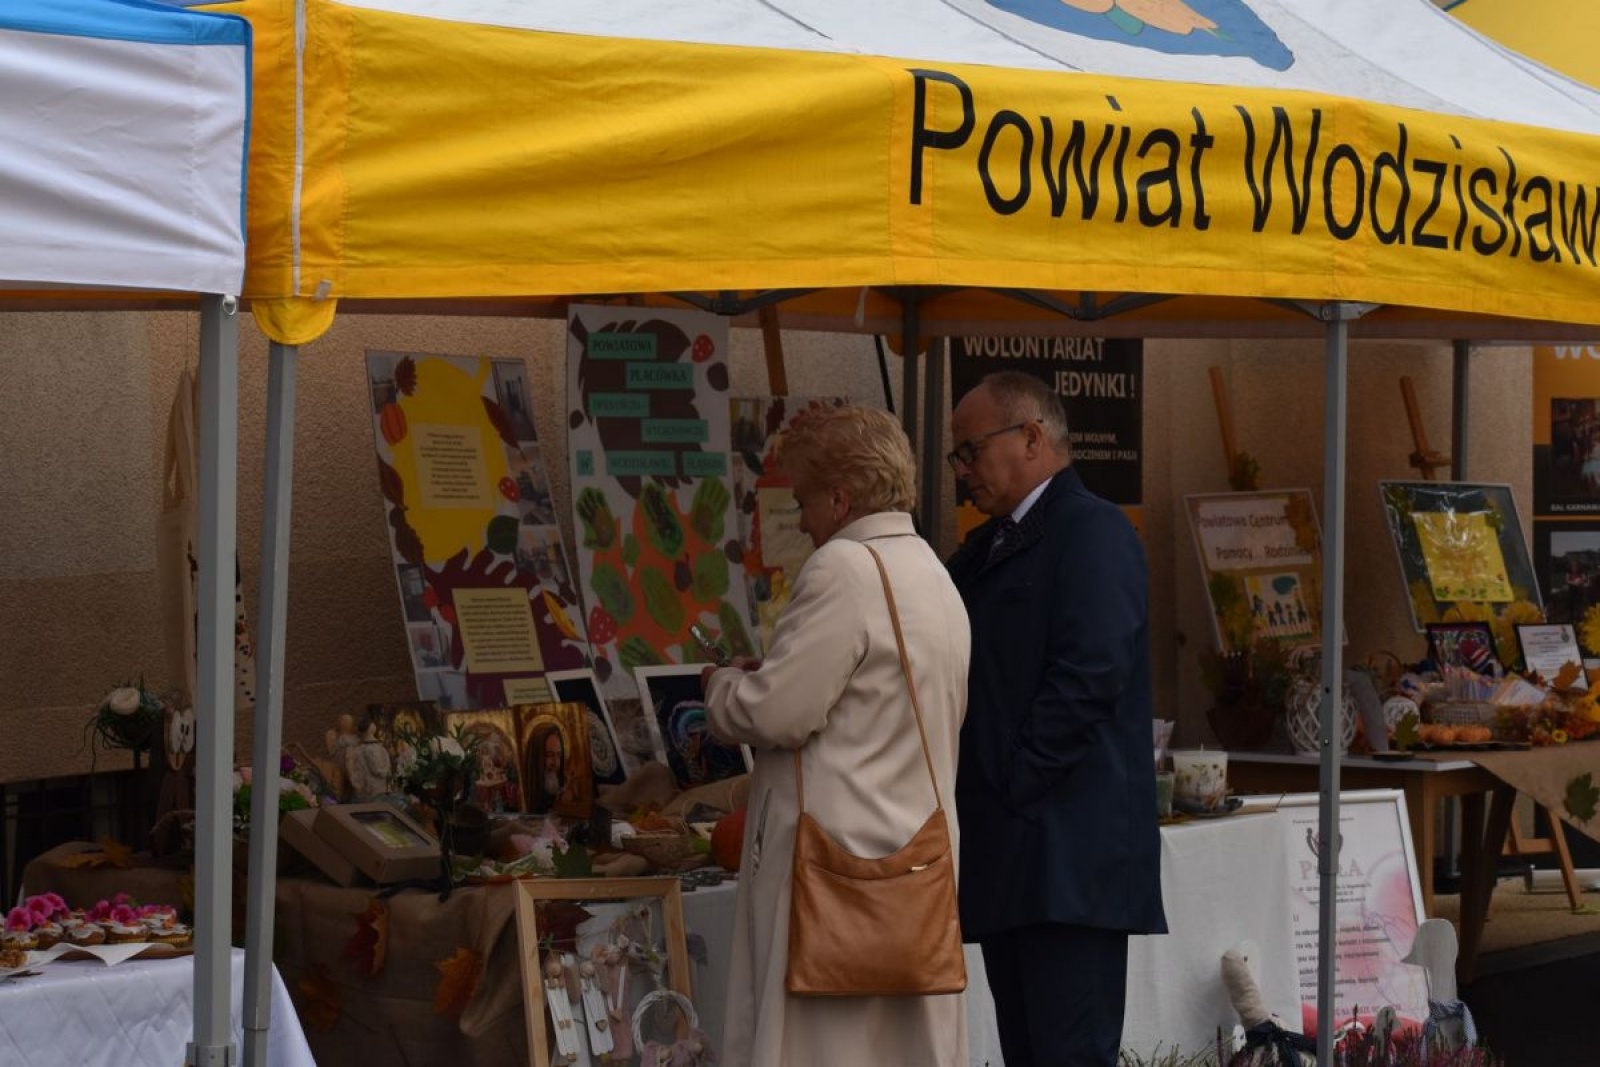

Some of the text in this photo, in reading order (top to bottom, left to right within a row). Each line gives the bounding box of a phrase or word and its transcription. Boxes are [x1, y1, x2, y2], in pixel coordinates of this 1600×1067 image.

[906, 68, 1600, 267] Powiat Wodzisław
[592, 340, 652, 354] POWIATOWA
[963, 335, 1105, 362] WOLONTARIAT
[1055, 371, 1126, 397] JEDYNKI
